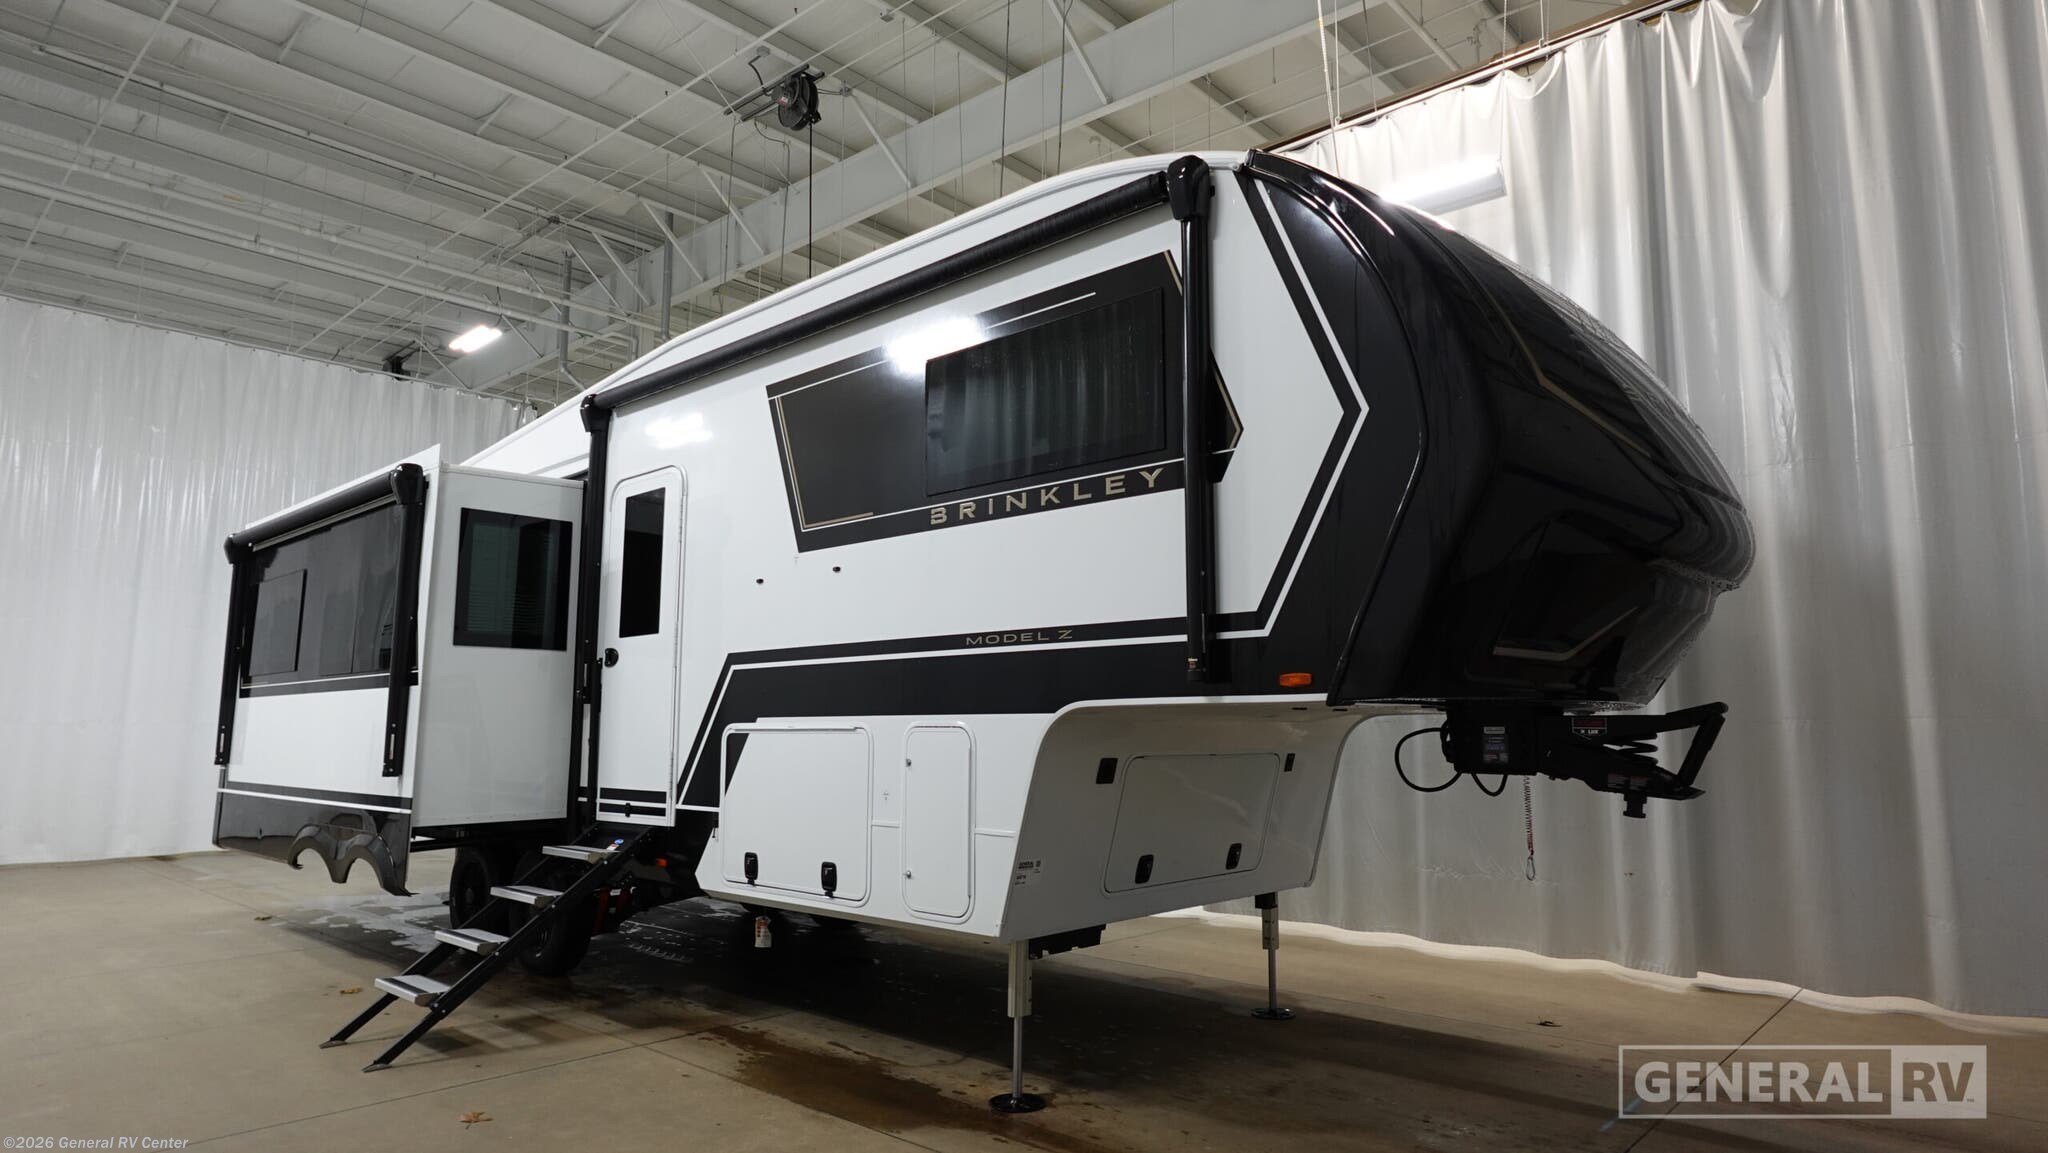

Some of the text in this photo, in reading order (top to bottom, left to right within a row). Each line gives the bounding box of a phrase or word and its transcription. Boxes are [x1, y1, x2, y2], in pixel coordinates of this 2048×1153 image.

[930, 467, 1164, 525] BRINKLEY
[966, 629, 1073, 646] MODEL Z
